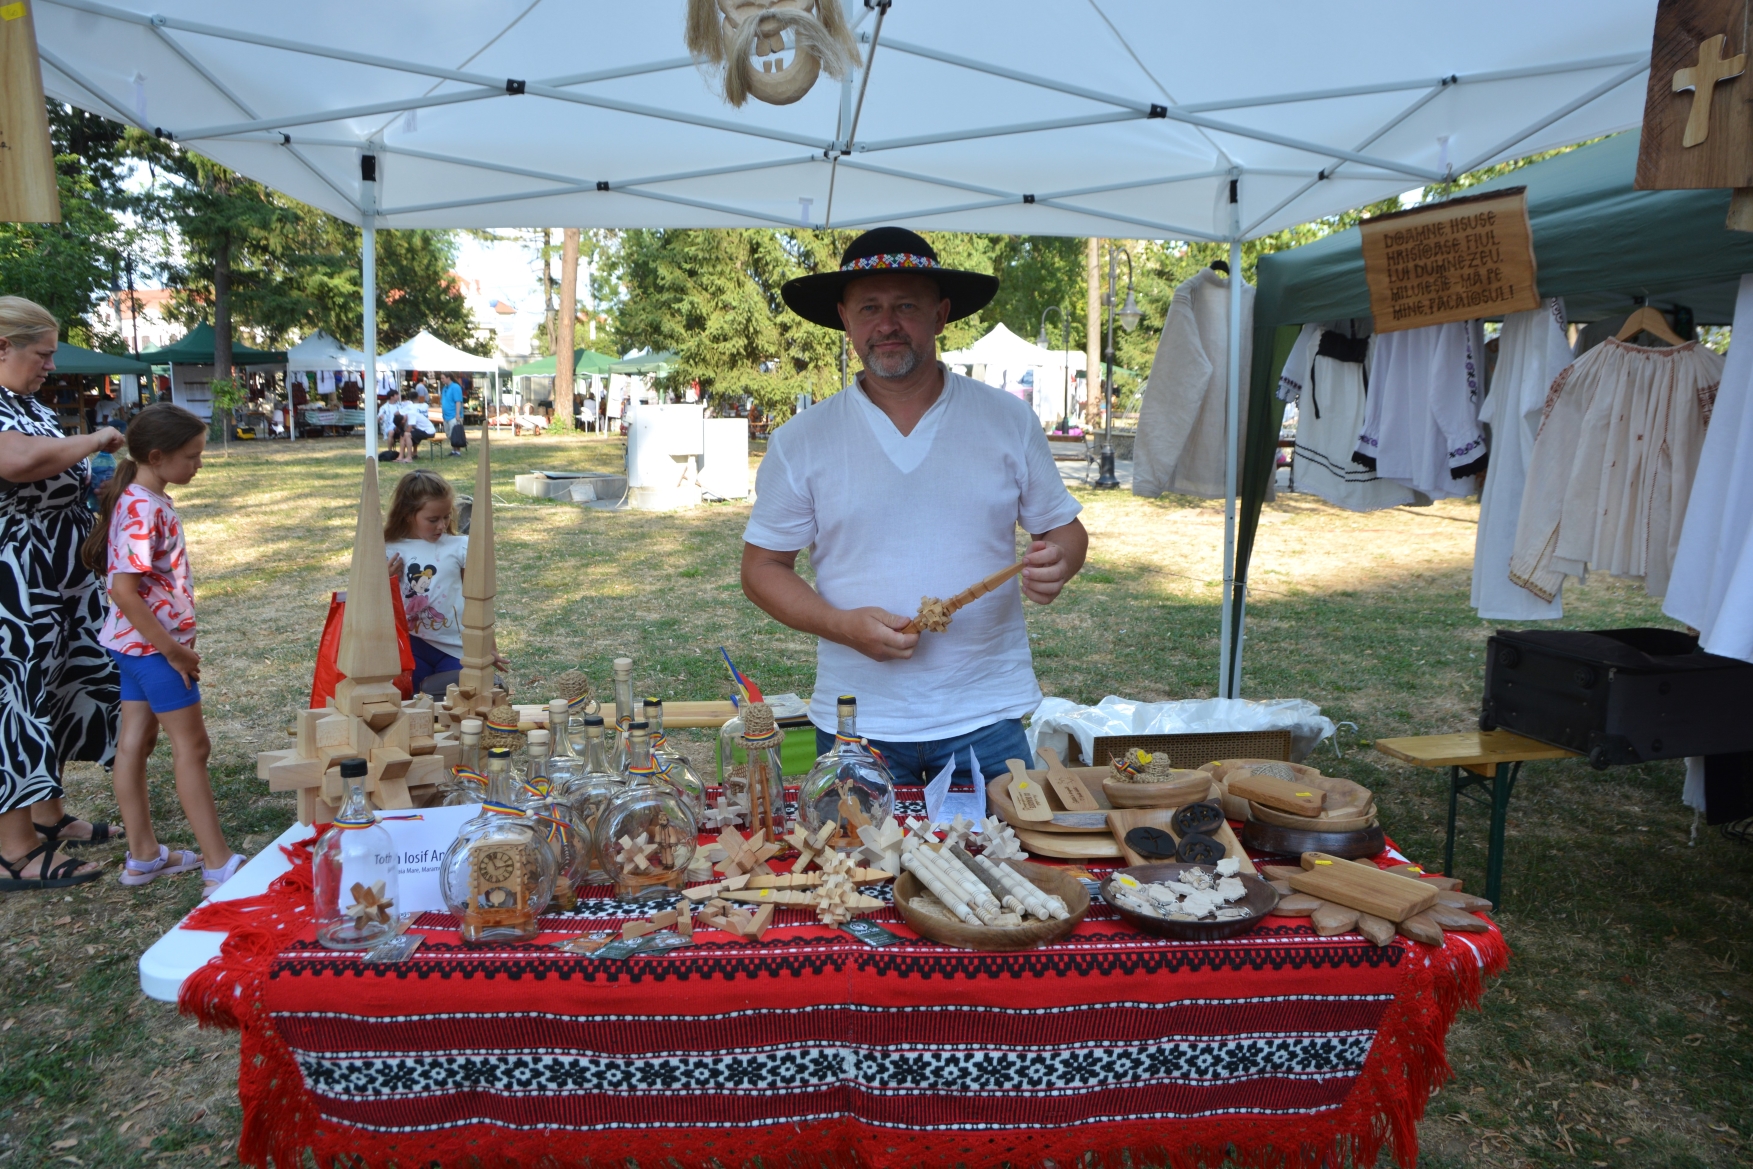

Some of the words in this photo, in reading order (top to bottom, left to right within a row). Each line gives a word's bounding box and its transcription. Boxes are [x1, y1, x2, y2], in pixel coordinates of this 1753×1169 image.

[1465, 229, 1501, 252] FIUL
[1387, 266, 1411, 284] LUI
[1486, 266, 1503, 285] PE
[404, 849, 429, 864] Iosif
